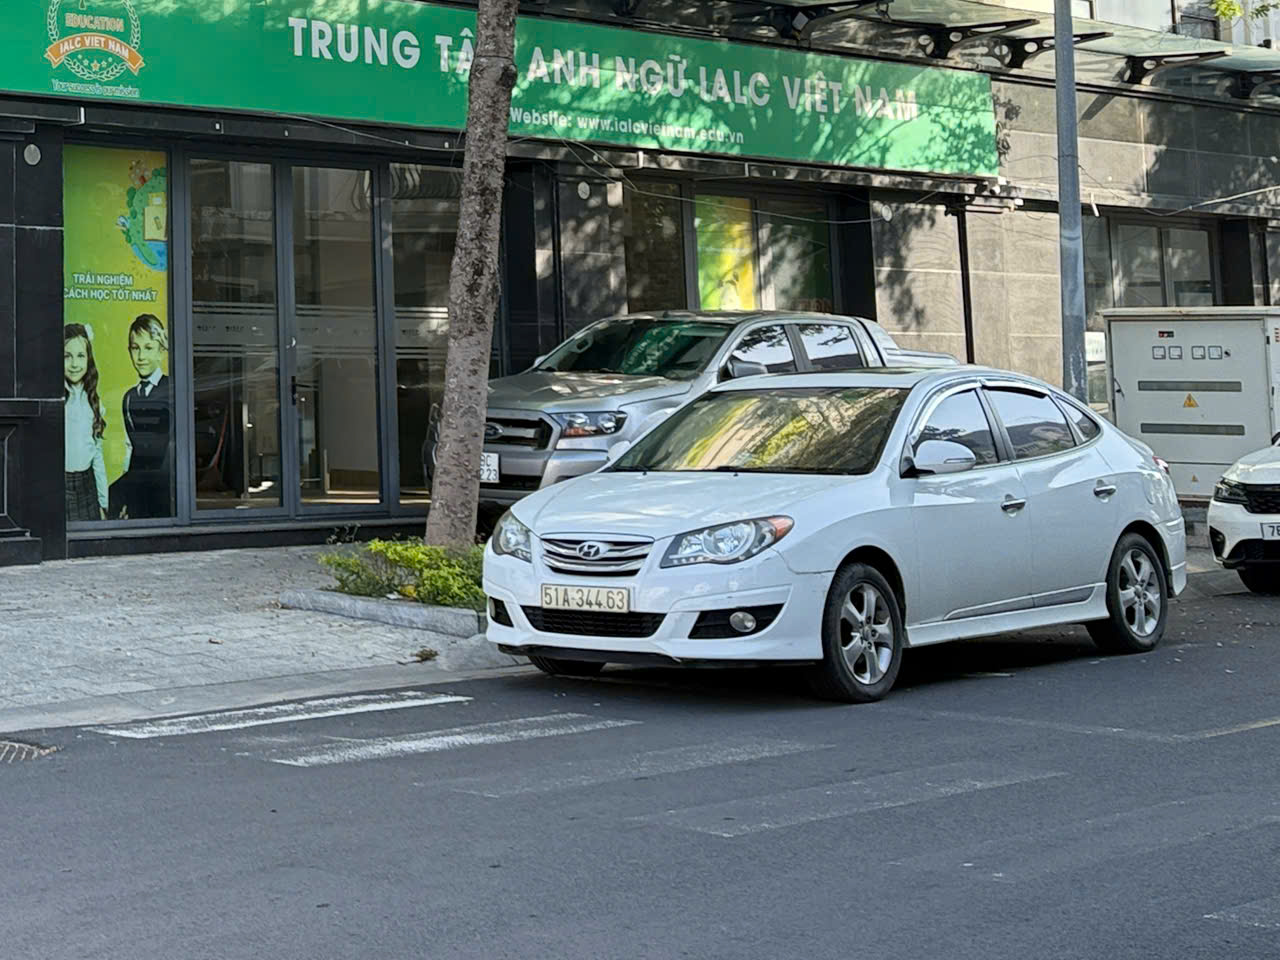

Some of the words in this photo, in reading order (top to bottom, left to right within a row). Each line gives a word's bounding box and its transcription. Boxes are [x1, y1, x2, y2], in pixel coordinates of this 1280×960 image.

[60, 37, 82, 55] IALC
[84, 35, 106, 48] VIET
[108, 39, 129, 59] NAM
[287, 16, 421, 70] TRUNG
[435, 27, 475, 75] TÂ
[527, 46, 601, 89] ANH
[615, 44, 688, 98] NGỮ
[699, 56, 771, 107] IALC
[782, 70, 843, 123] VIỆT
[854, 84, 918, 121] NAM
[510, 106, 572, 128] Website:
[64, 286, 88, 299] CÁCH
[90, 288, 110, 301] HỌC
